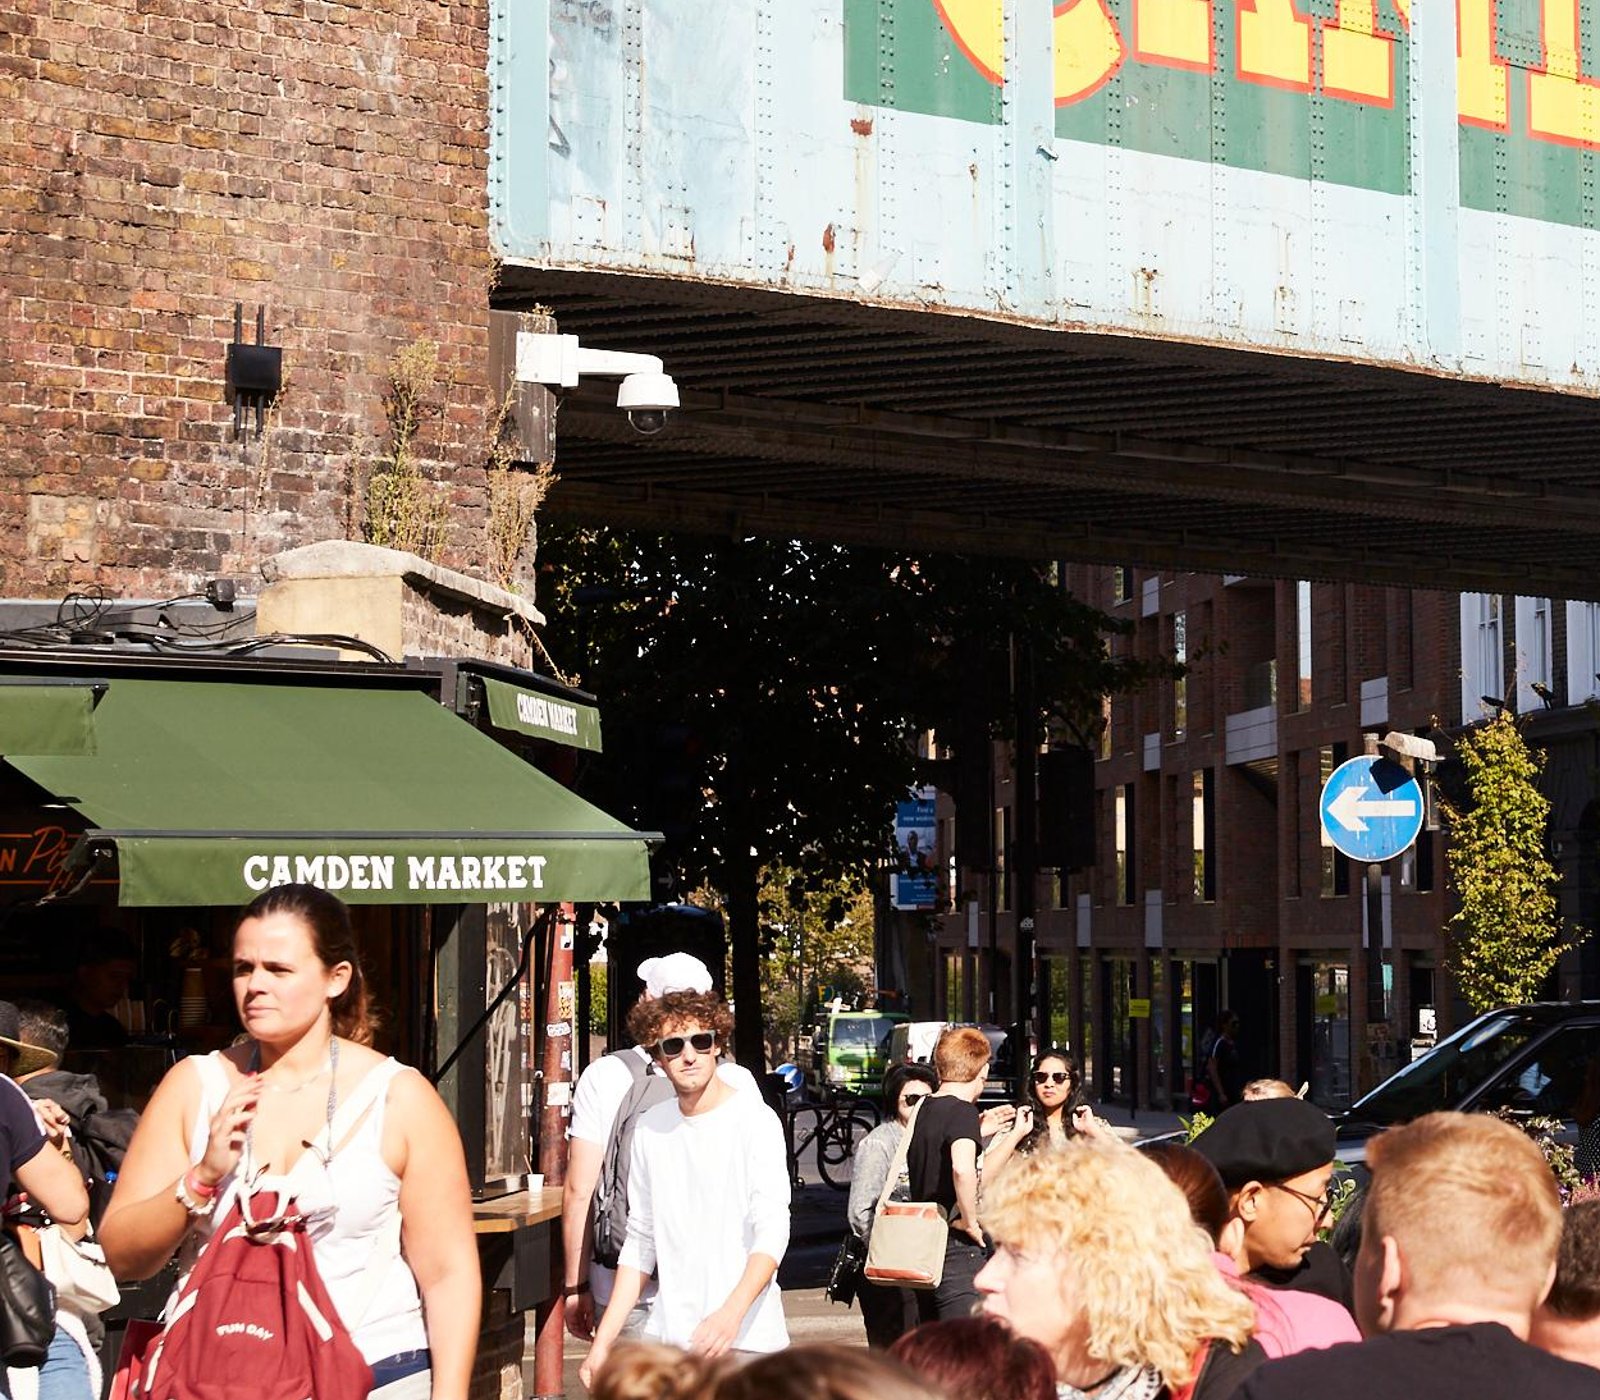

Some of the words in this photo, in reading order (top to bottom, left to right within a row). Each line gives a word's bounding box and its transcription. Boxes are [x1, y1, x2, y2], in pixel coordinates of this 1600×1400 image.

[517, 693, 549, 727] CAMDEN
[548, 701, 577, 735] MARKET
[243, 855, 395, 890] CAMDEN
[407, 856, 547, 890] MARKET
[216, 1322, 245, 1337] FUN
[246, 1323, 274, 1341] DAY
